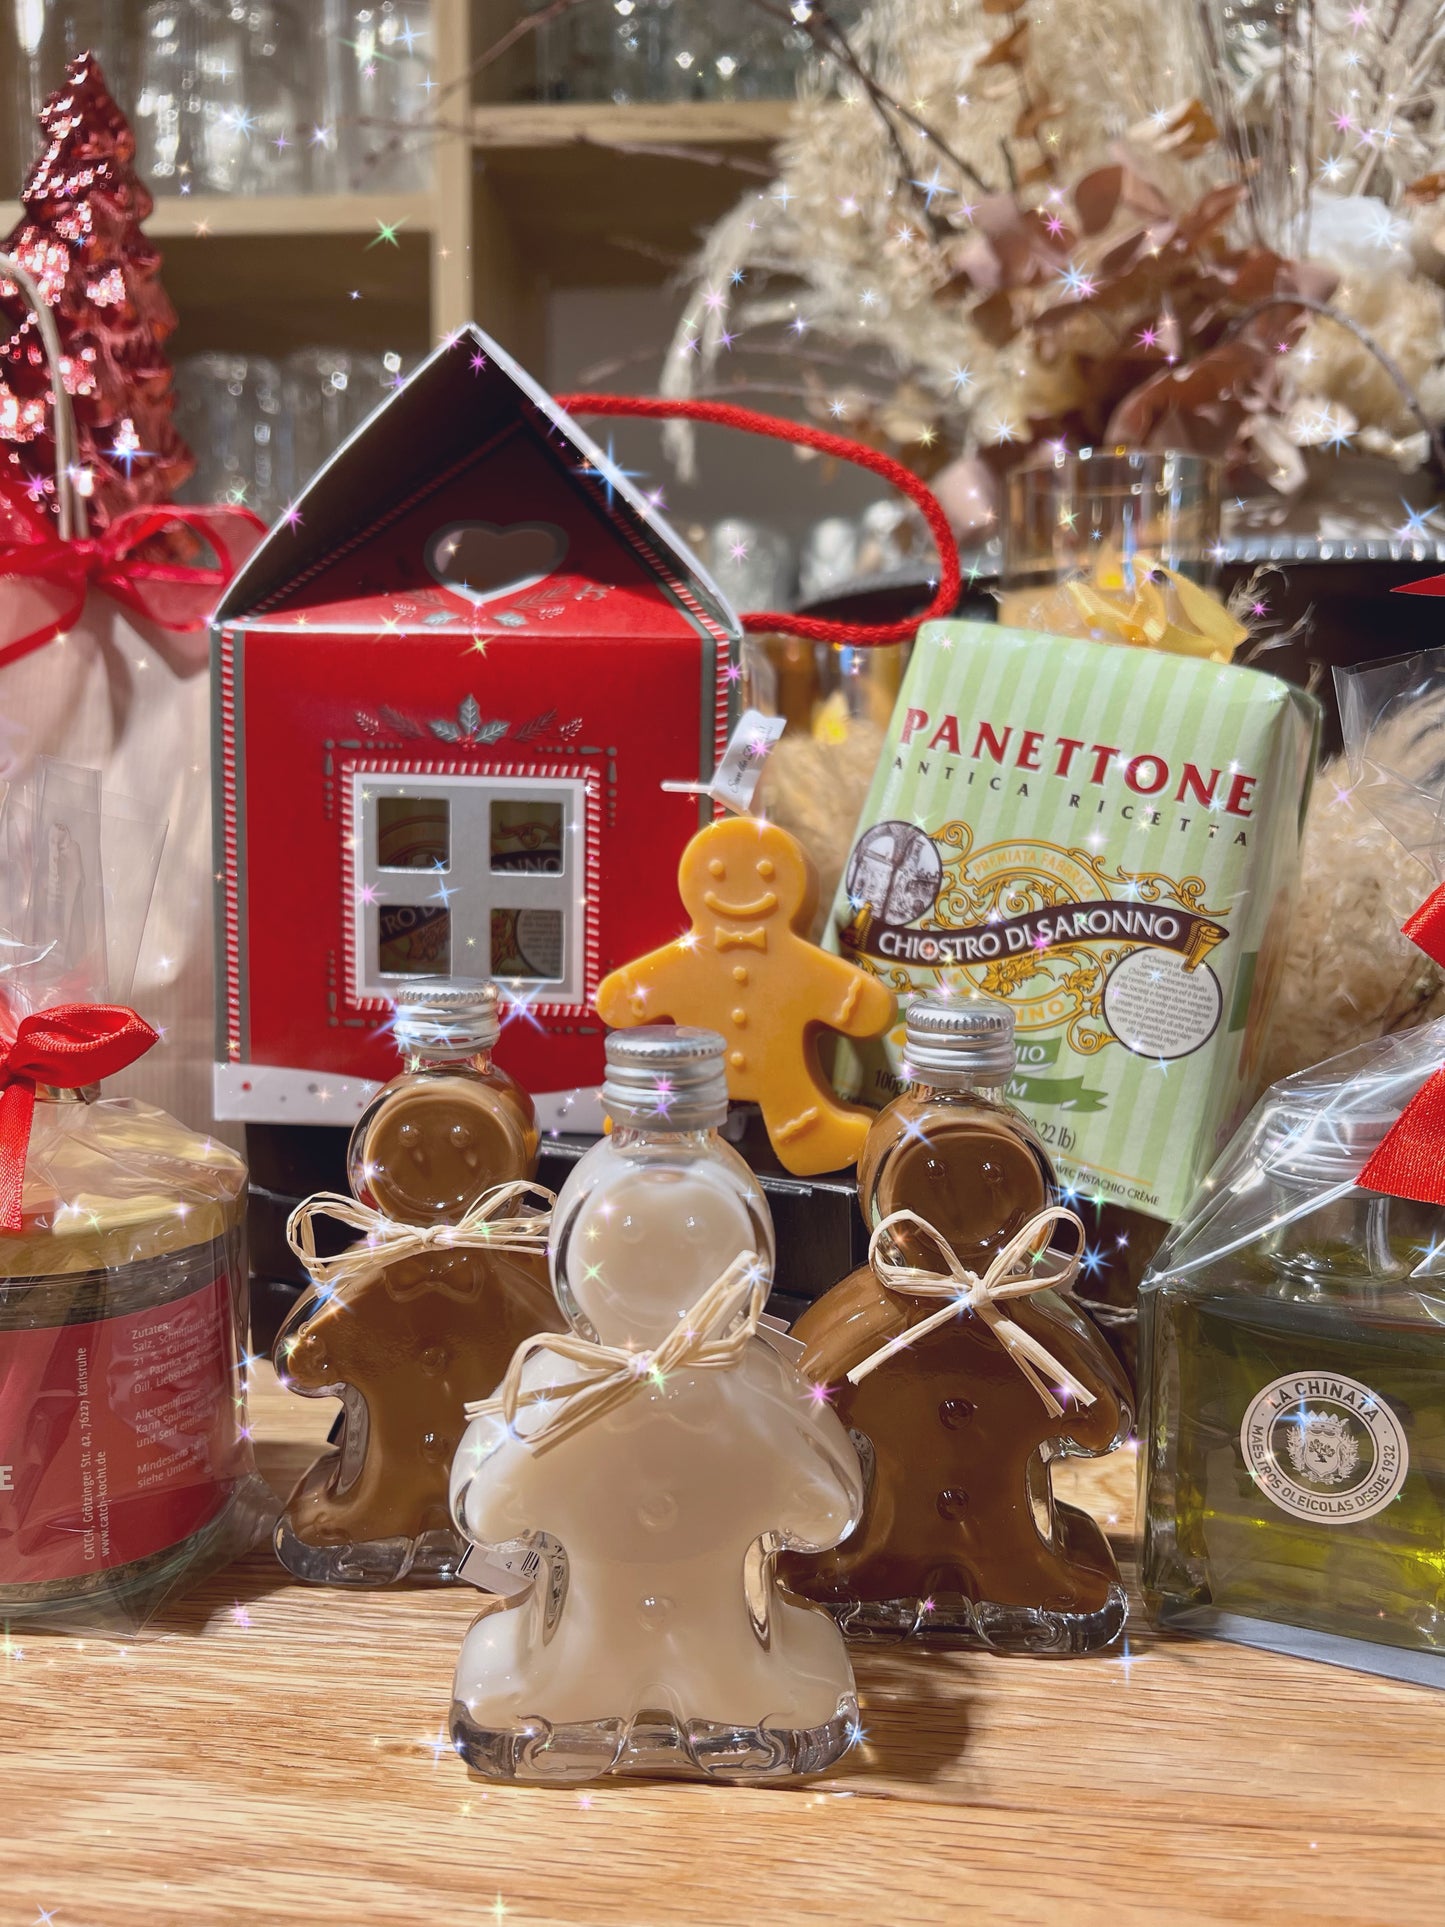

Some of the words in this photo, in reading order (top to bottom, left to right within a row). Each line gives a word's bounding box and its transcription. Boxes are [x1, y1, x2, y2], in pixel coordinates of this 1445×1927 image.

[899, 707, 1257, 818] PANETTONE
[894, 756, 1030, 798] ANTICA
[1069, 793, 1248, 846] RICETTA
[973, 850, 1037, 876] PREMIATA
[1041, 852, 1096, 898] FABBRICA
[878, 930, 1000, 961] CHIOSTRO
[1005, 924, 1034, 951] DI
[1036, 908, 1180, 943] SARONNO
[1057, 1125, 1077, 1151] lb)
[1055, 1164, 1075, 1179] AVEC
[1077, 1171, 1126, 1195] PISTACHIO
[1127, 1188, 1160, 1206] CRÈME
[76, 1347, 88, 1397] Karlsruhe
[79, 1400, 92, 1429] 76227
[1270, 1388, 1292, 1410] LA
[1294, 1380, 1379, 1423] CHINATA
[82, 1431, 92, 1447] 42,
[136, 1420, 161, 1434] Kann
[136, 1433, 156, 1448] und
[159, 1424, 178, 1440] Senf
[0, 1465, 14, 1491] E
[81, 1450, 91, 1468] Str.
[1252, 1424, 1283, 1489] MAESTROS
[1281, 1486, 1354, 1513] OLEÍCOLAS
[1356, 1476, 1390, 1507] DESDE
[1382, 1445, 1396, 1473] 1932
[82, 1471, 95, 1522] Grötzinger
[137, 1472, 164, 1488] siehe
[96, 1451, 110, 1557] www.catch-kocht.de
[83, 1525, 96, 1560] CATCH,
[505, 1561, 513, 1570] 4
